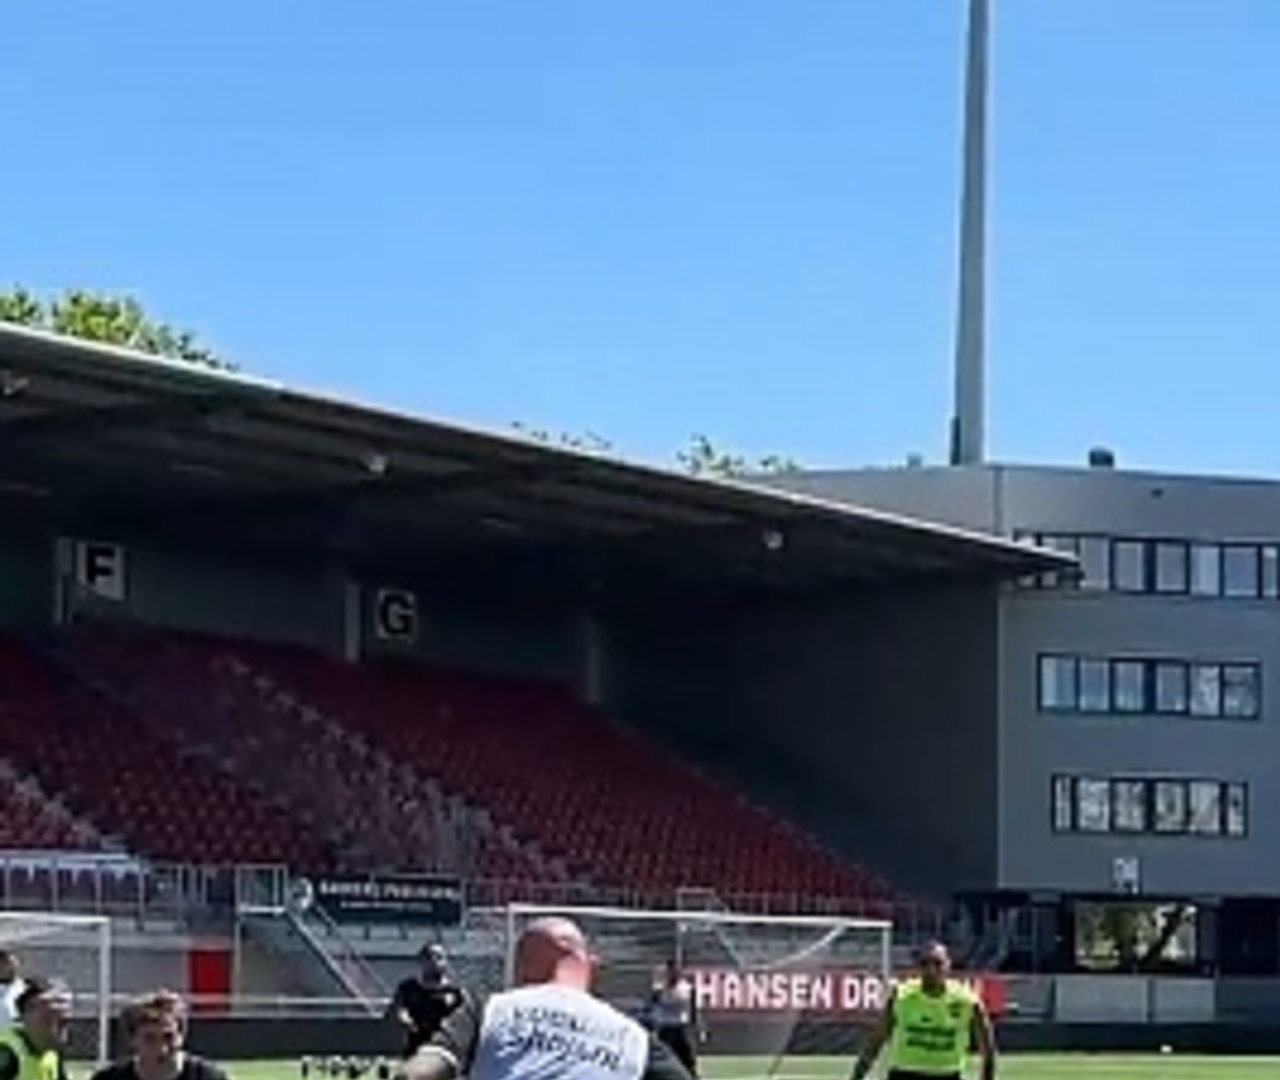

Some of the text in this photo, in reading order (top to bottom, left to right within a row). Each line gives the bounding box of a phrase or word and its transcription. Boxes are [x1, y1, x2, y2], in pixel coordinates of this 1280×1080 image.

[87, 546, 116, 585] F
[379, 594, 413, 636] G
[695, 973, 833, 1010] HANSEN
